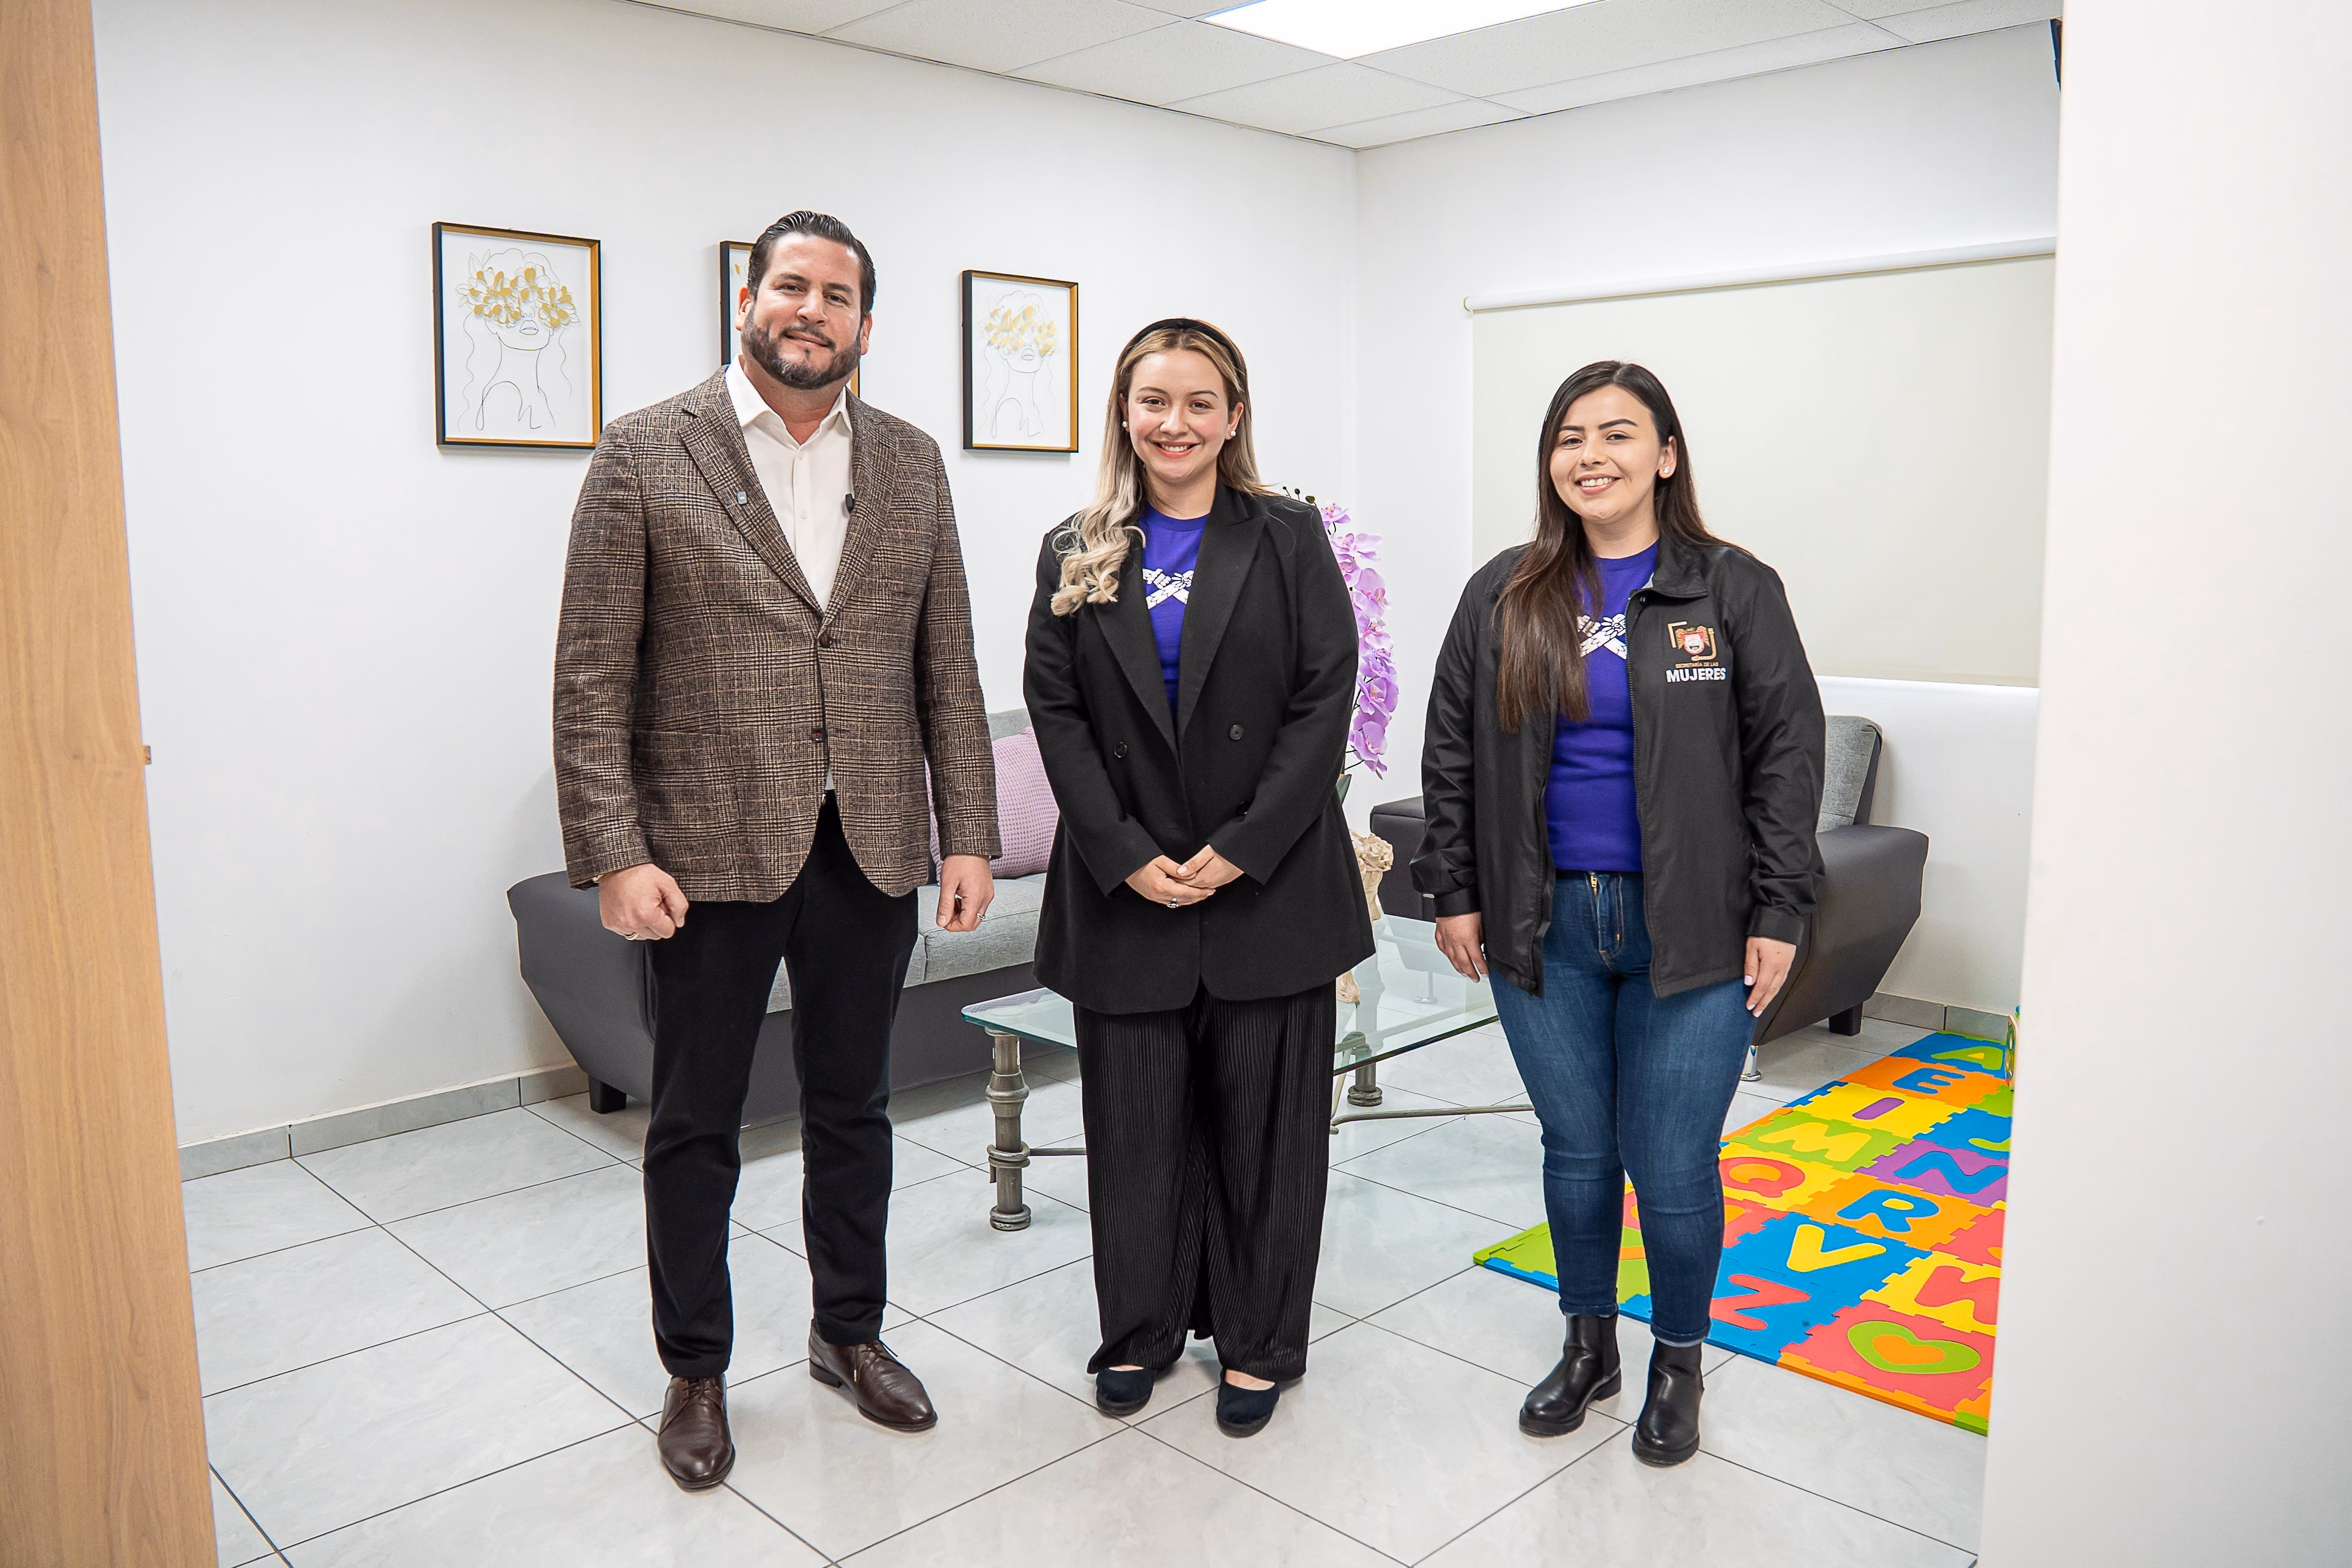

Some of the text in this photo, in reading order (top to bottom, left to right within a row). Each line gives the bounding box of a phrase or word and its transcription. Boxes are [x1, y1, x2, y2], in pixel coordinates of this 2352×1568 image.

[1666, 668, 1726, 683] MUJERES
[1931, 1046, 2004, 1070] A
[1892, 1068, 1966, 1094] E
[1758, 1123, 1873, 1162] M
[1719, 1156, 1806, 1198] Q
[1894, 1151, 2009, 1194] N
[1837, 1189, 1939, 1233] R
[1787, 1224, 1887, 1272] V
